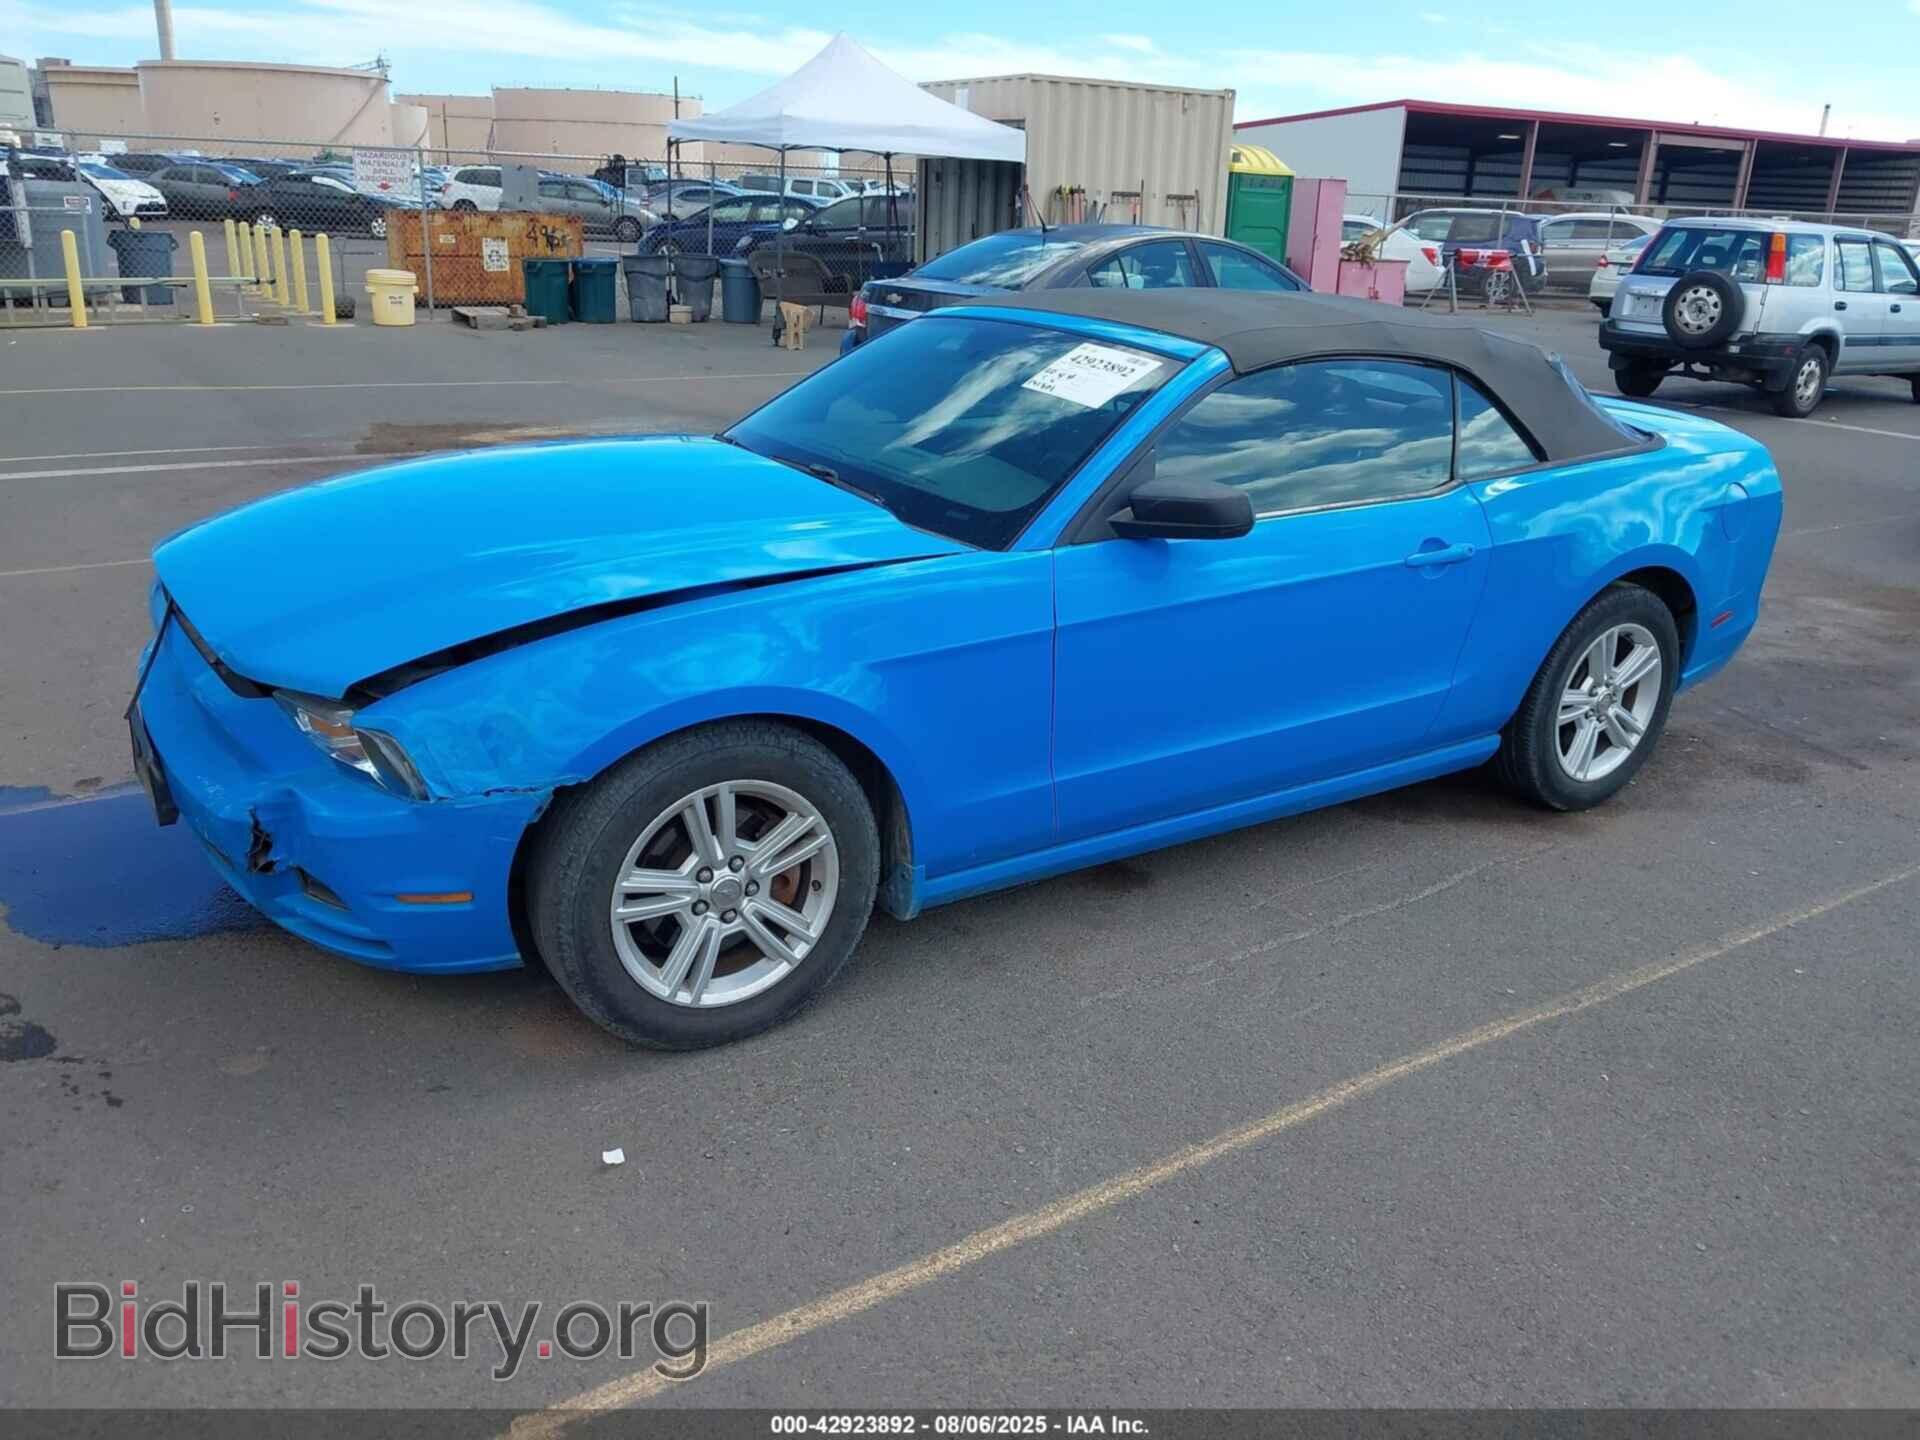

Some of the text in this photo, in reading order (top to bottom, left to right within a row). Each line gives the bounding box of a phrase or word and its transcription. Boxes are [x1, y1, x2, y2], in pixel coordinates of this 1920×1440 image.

[356, 151, 409, 160] HAZARDOUS
[359, 159, 407, 168] MATERIALS
[372, 167, 396, 175] SPILL
[1070, 354, 1136, 377] 42923892
